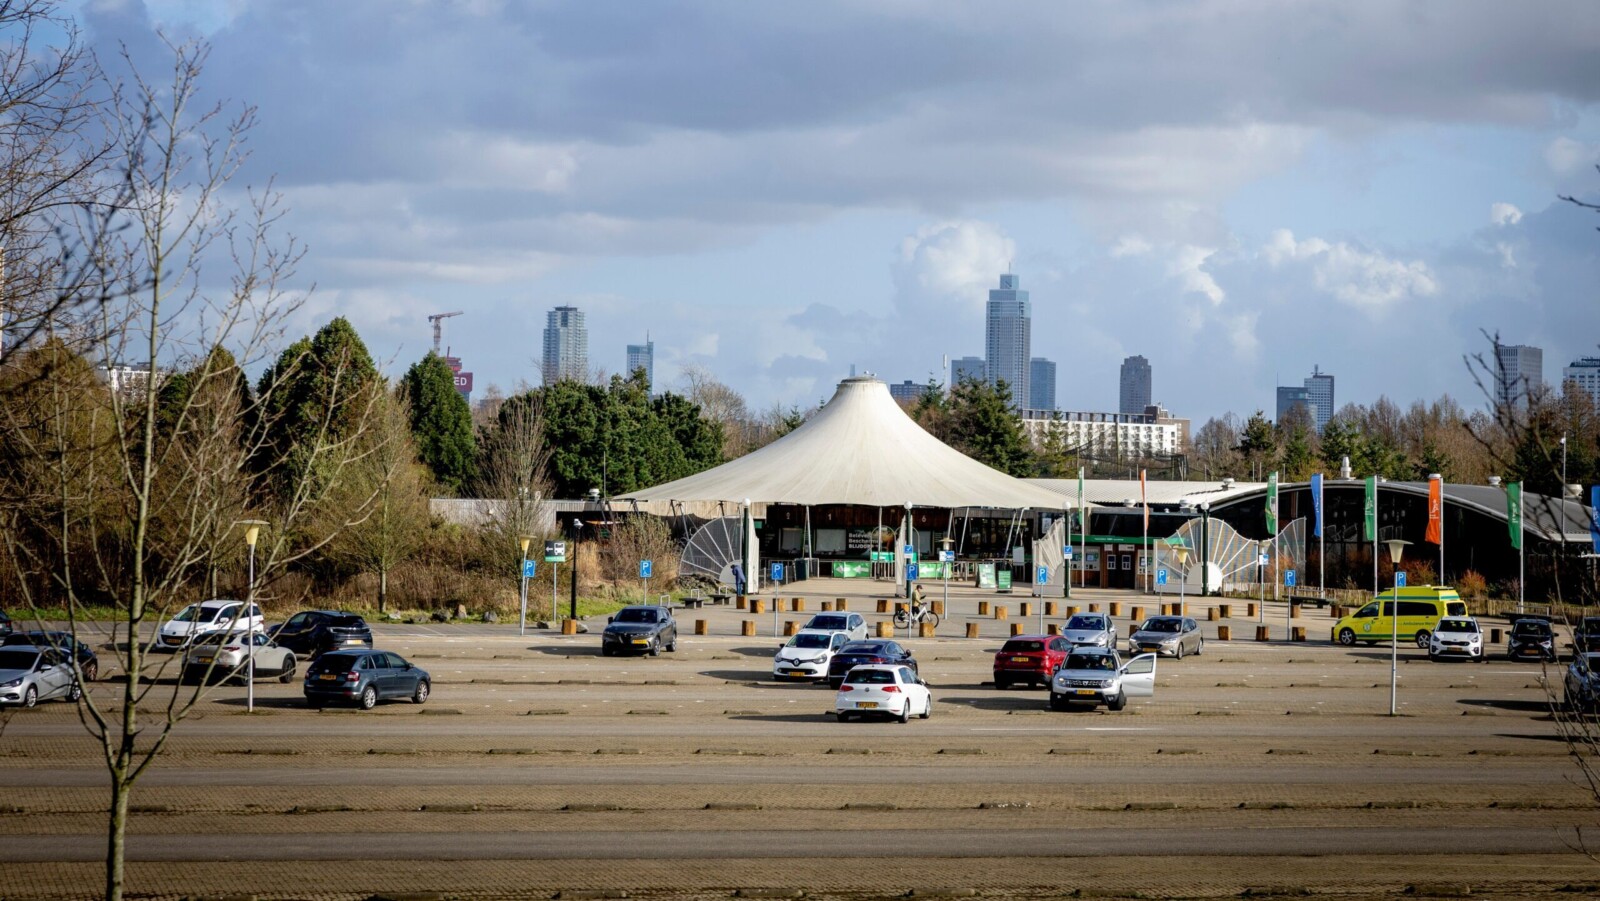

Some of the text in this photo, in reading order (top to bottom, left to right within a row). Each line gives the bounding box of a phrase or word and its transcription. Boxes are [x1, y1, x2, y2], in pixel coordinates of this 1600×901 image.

[526, 561, 533, 569] P
[642, 561, 649, 570] P
[774, 564, 781, 573] P
[909, 565, 915, 574] P
[1159, 570, 1165, 578] P
[1287, 571, 1293, 579] P
[1398, 573, 1404, 581] P
